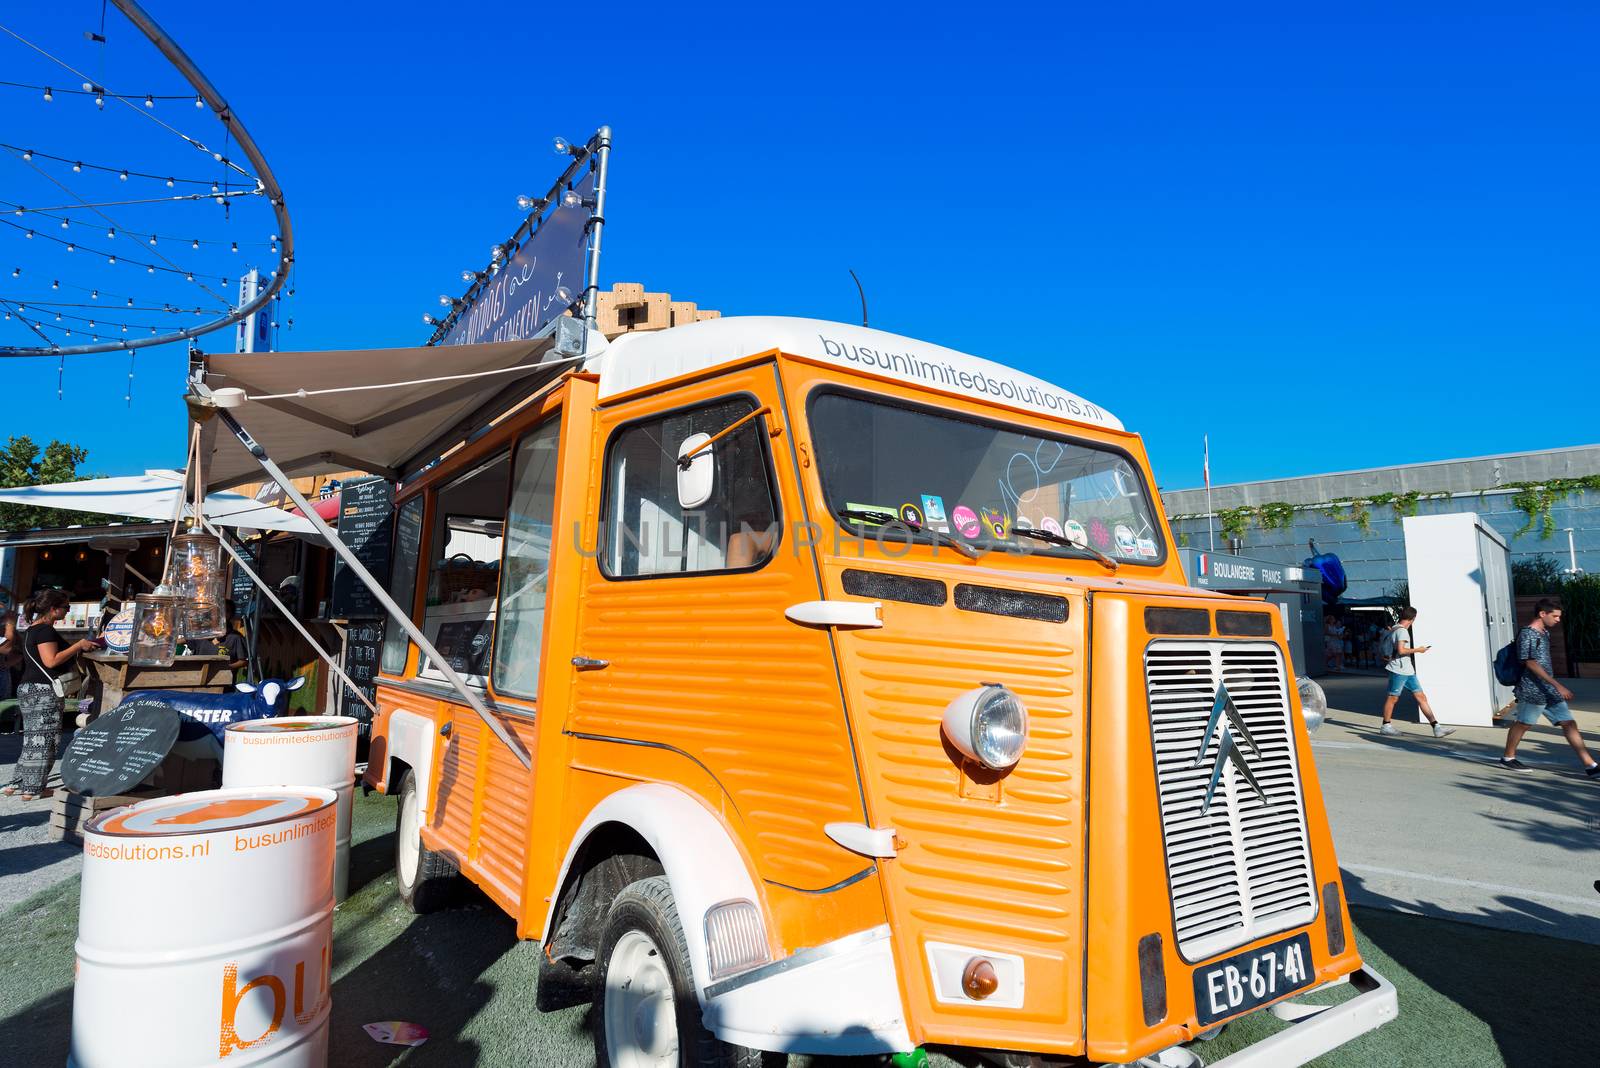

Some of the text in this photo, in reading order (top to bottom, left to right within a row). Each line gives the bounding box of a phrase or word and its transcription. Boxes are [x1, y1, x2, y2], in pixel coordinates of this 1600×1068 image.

[819, 334, 1103, 420] busunlimitedsolutions.nl
[1214, 562, 1255, 581] BOULANGERIE
[1262, 569, 1282, 584] FRANCE
[1207, 943, 1306, 1014] EB-67-41
